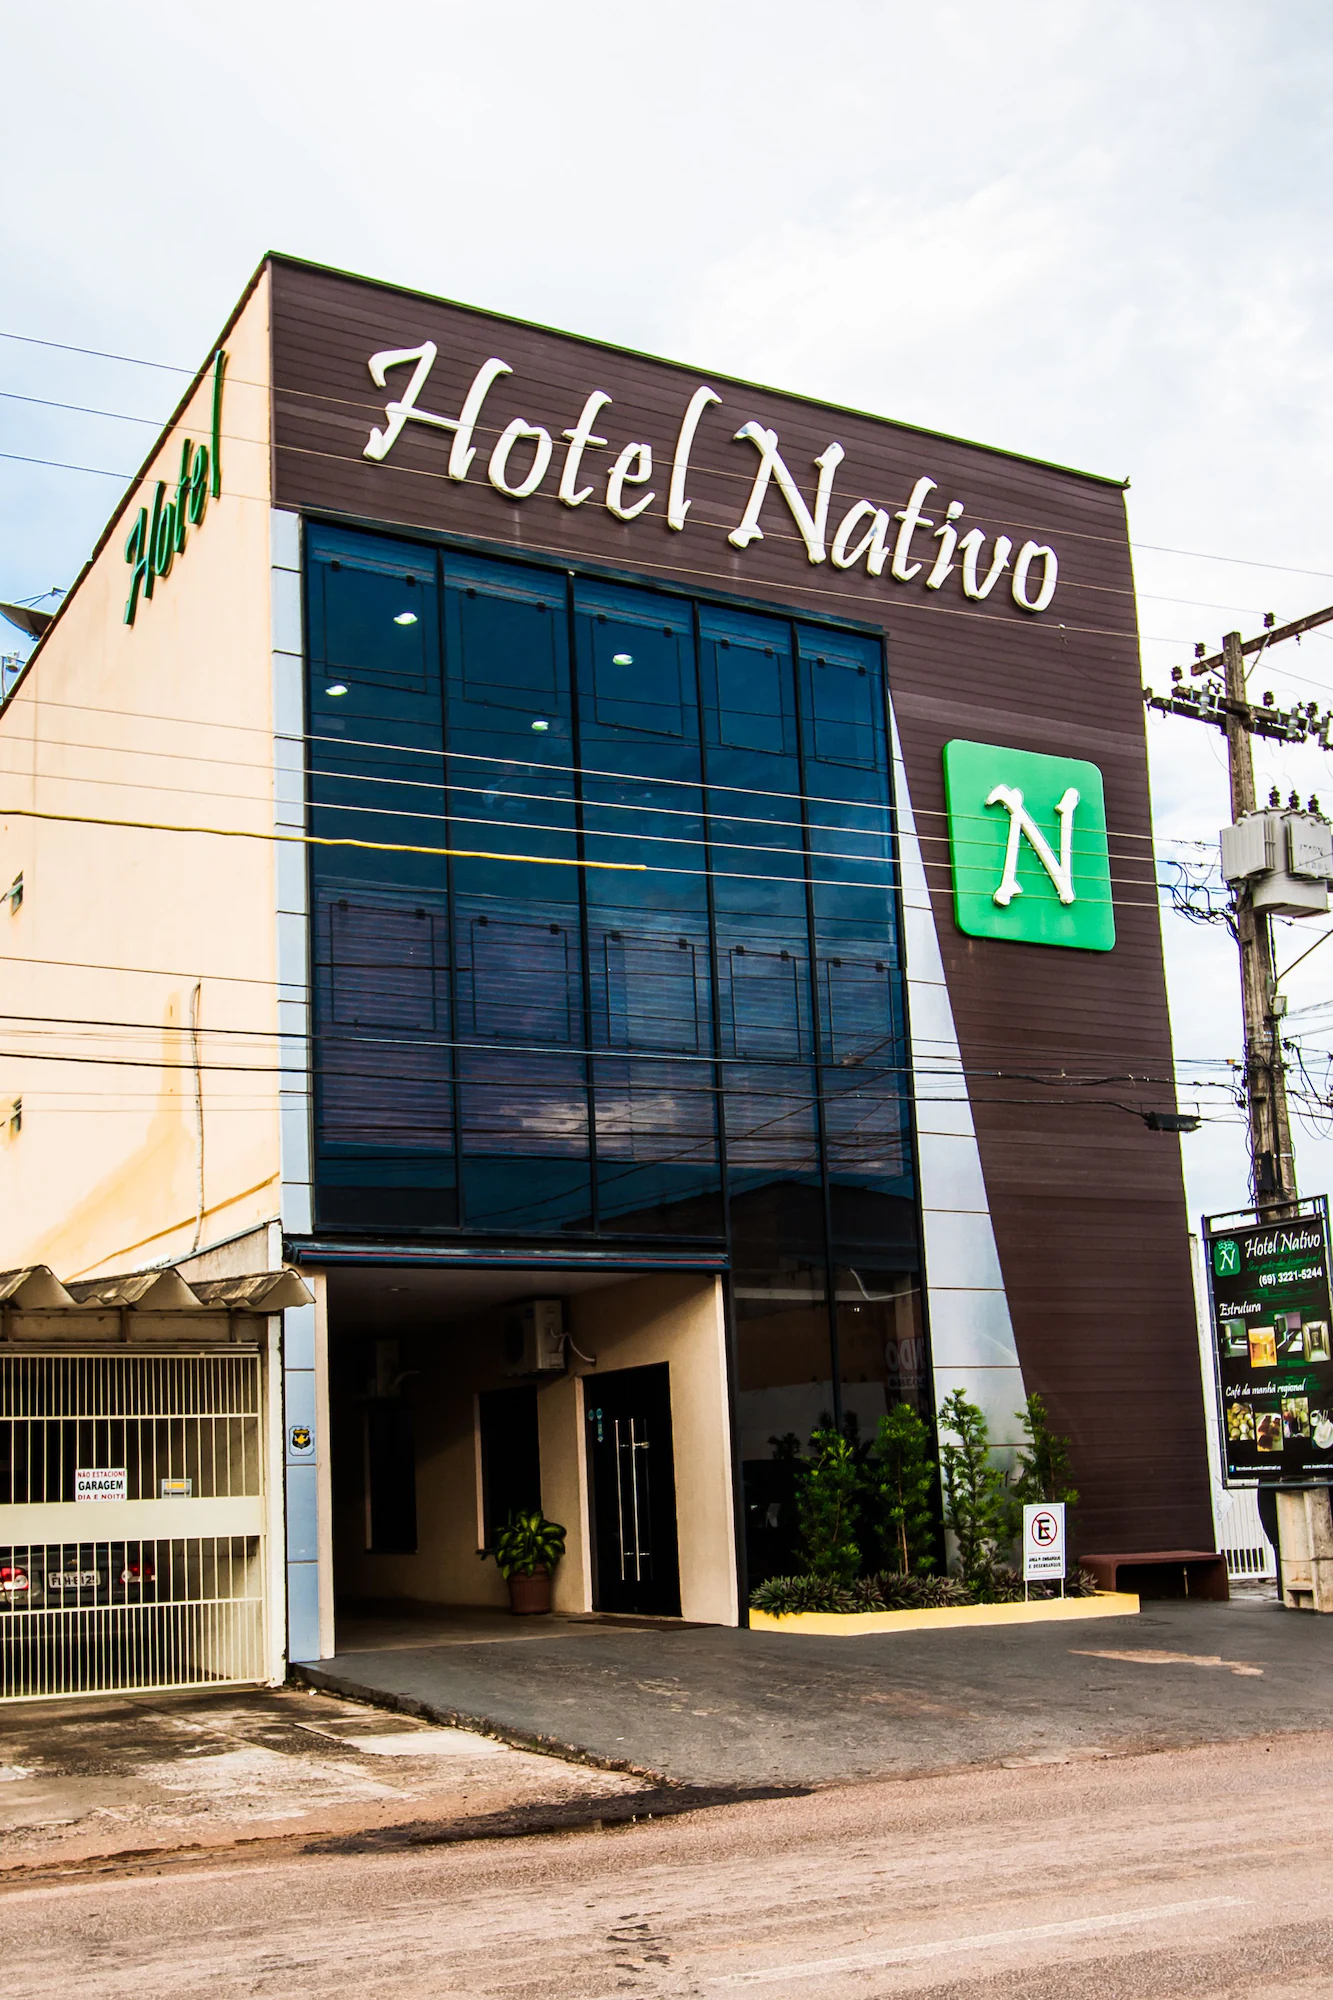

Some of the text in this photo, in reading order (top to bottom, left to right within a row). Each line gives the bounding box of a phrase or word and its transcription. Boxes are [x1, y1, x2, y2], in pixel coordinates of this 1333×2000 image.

[363, 340, 1059, 613] Hotel Nativo
[123, 350, 225, 626] Hotel
[984, 784, 1081, 905] N
[1245, 1230, 1321, 1258] Hotel Nativo
[1220, 1249, 1236, 1271] N
[1259, 1266, 1323, 1287] (69) 3221-5244
[1219, 1300, 1262, 1316] Estrutura
[1225, 1384, 1241, 1399] Café
[1241, 1383, 1251, 1396] da
[1277, 1378, 1306, 1398] regional
[77, 1470, 126, 1478] NÃO ESTACIONE
[78, 1480, 124, 1491] GARAGEM
